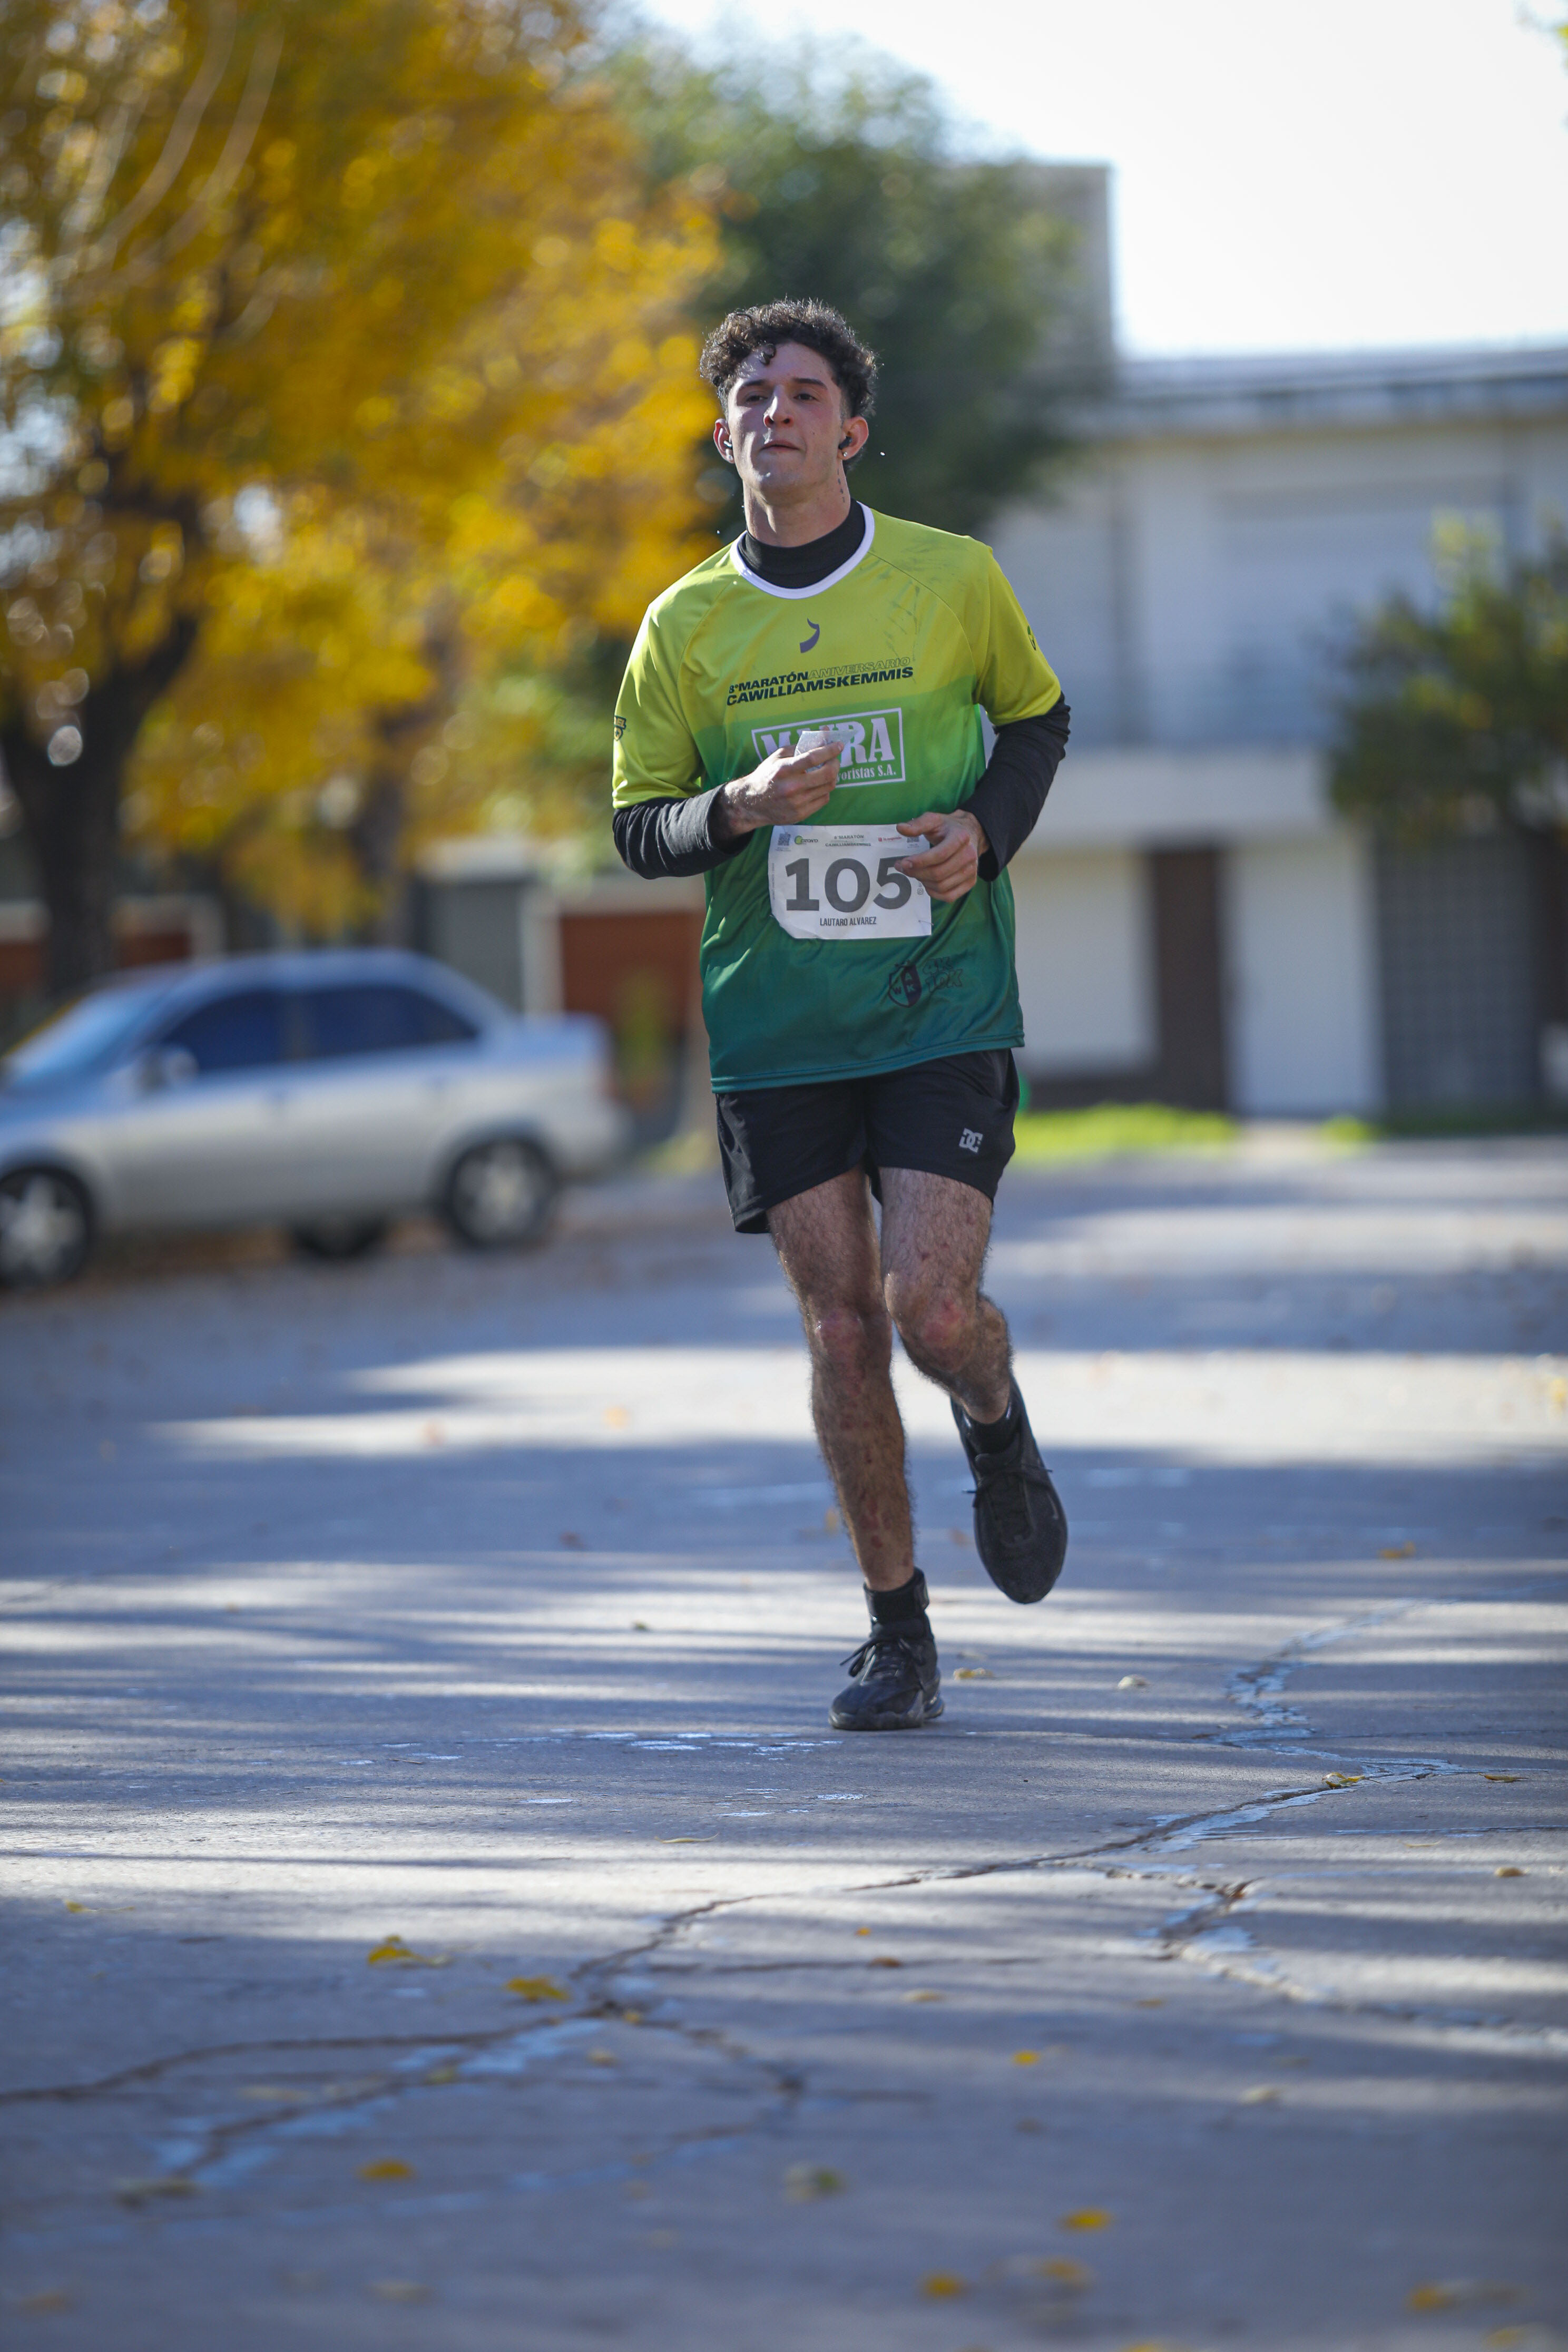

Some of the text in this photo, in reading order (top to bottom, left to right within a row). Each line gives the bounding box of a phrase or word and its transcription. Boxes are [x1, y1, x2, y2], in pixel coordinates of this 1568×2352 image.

[808, 656, 910, 679] ANIVERSARIO
[727, 667, 913, 706] CAWILLIAMSKEMMIS
[877, 763, 896, 777] S.A.
[785, 855, 912, 913] 105
[820, 917, 877, 926] LAUTARO ALVAREZ
